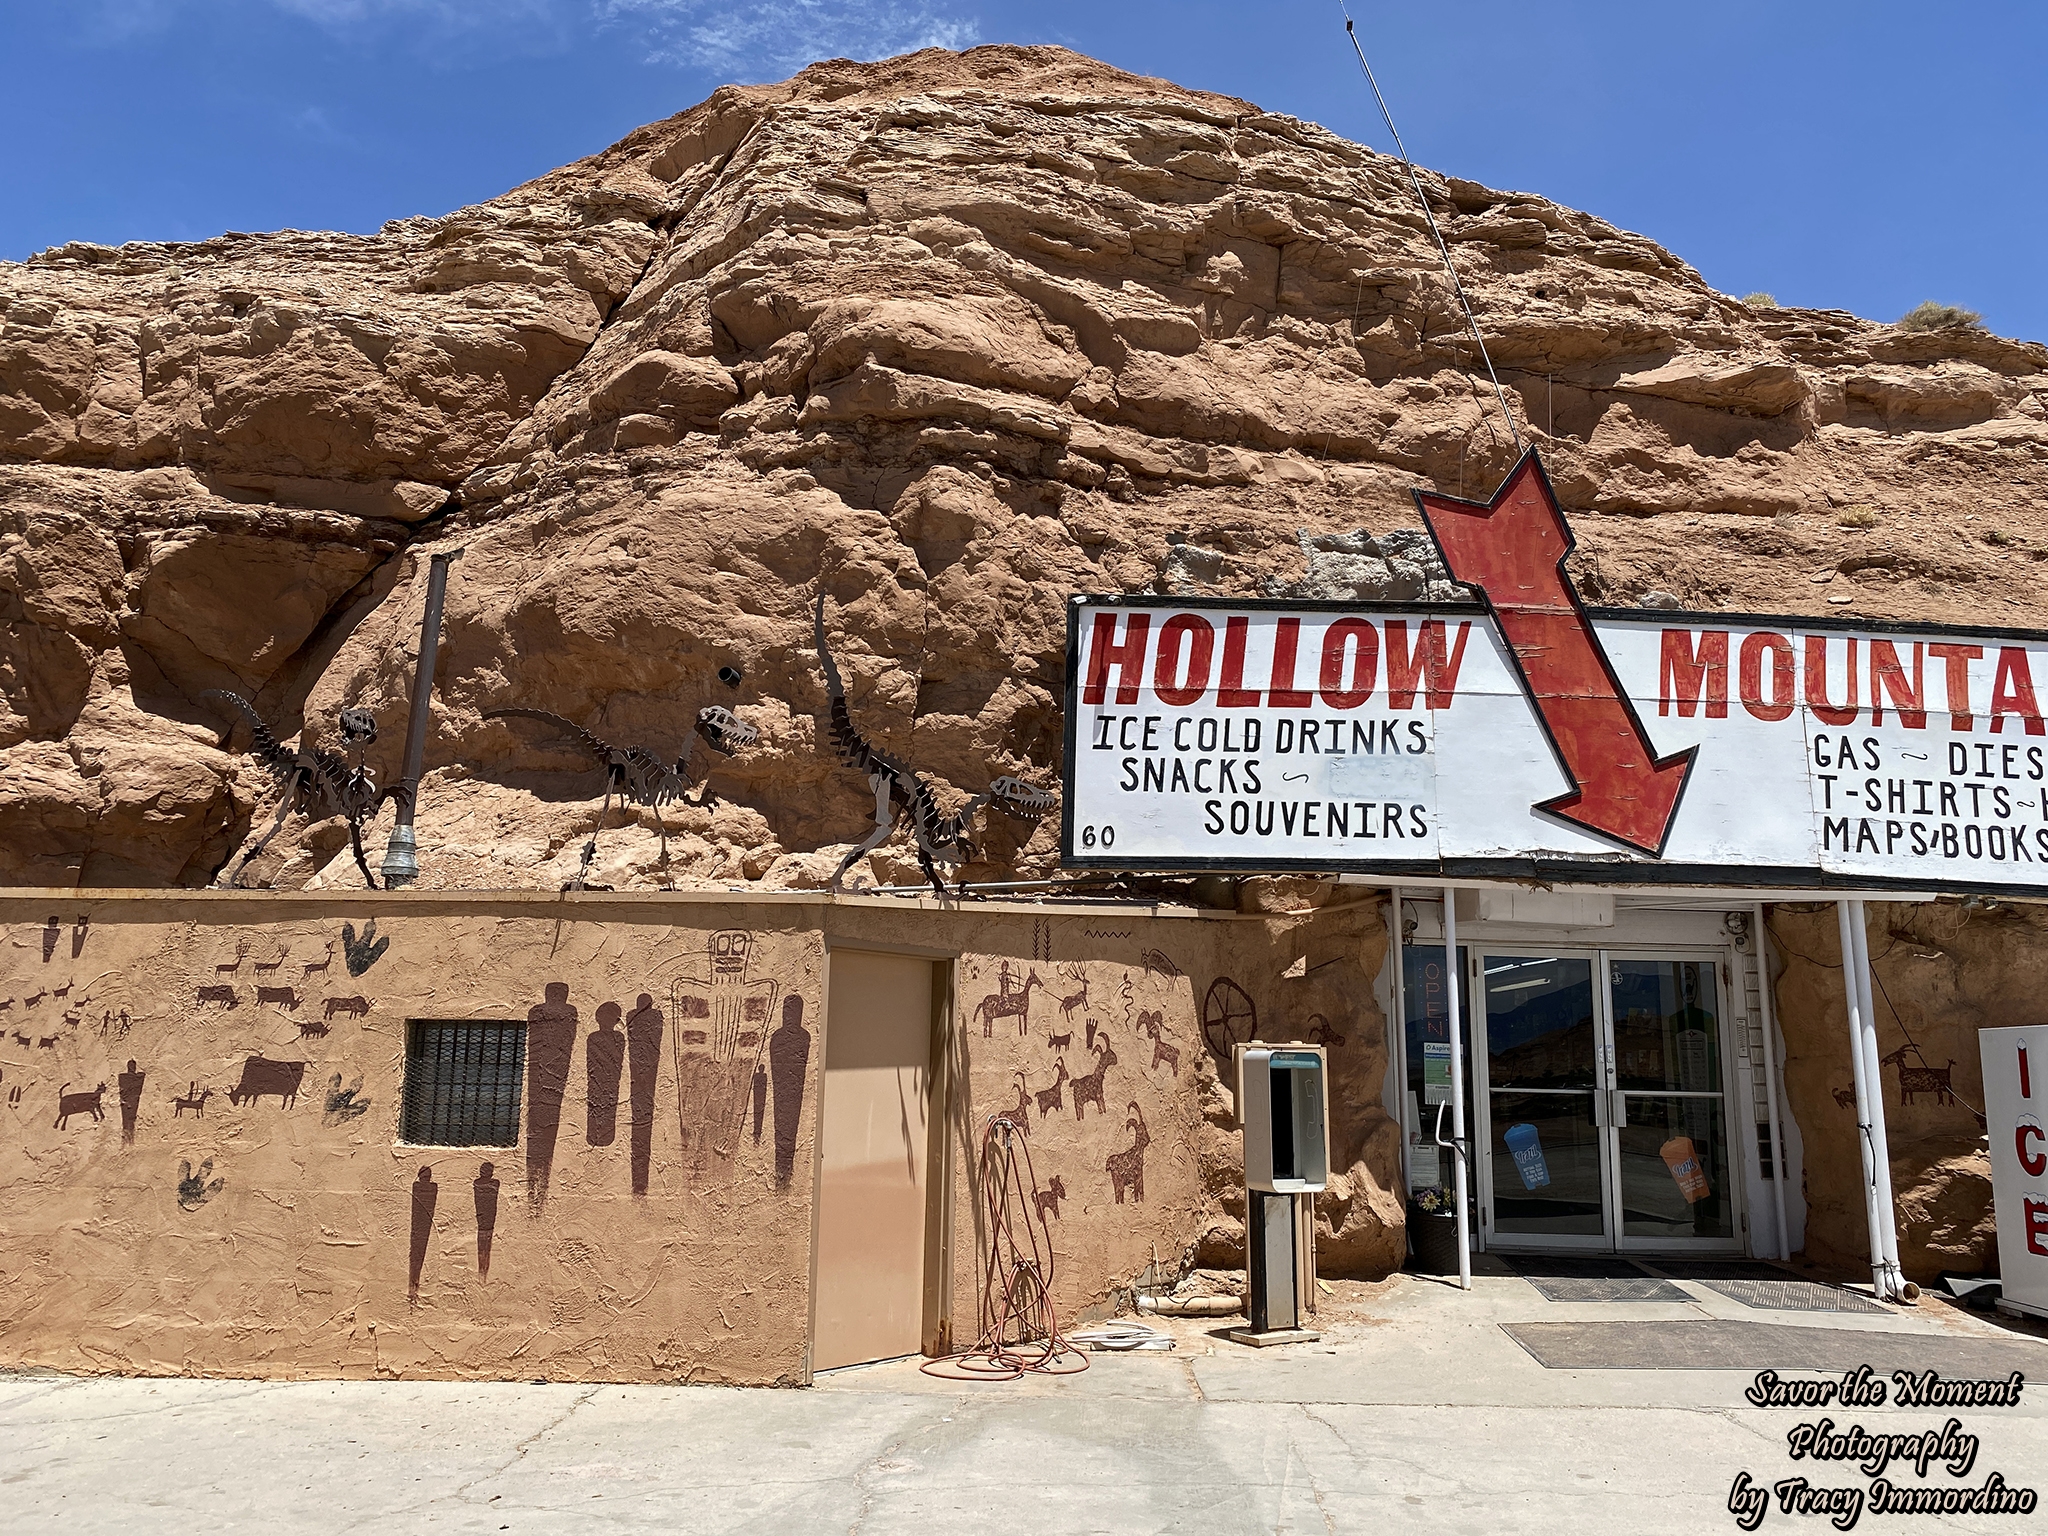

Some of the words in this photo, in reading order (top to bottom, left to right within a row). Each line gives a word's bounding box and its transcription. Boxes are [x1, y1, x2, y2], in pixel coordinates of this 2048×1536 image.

[1082, 612, 1472, 710] HOLLOW
[1658, 628, 2047, 736] MOUNTA
[1092, 715, 1161, 750] ICE
[1174, 717, 1262, 753] COLD
[1276, 718, 1427, 755] DRINKS
[1119, 757, 1262, 795] SNACKS
[1813, 733, 1880, 771] GAS
[1948, 741, 2044, 780] DIES
[1817, 774, 2011, 819] T-SHIRTS
[1081, 825, 1115, 848] 60
[1204, 799, 1428, 839] SOUVENIRS
[1425, 962, 1443, 1037] OPEN
